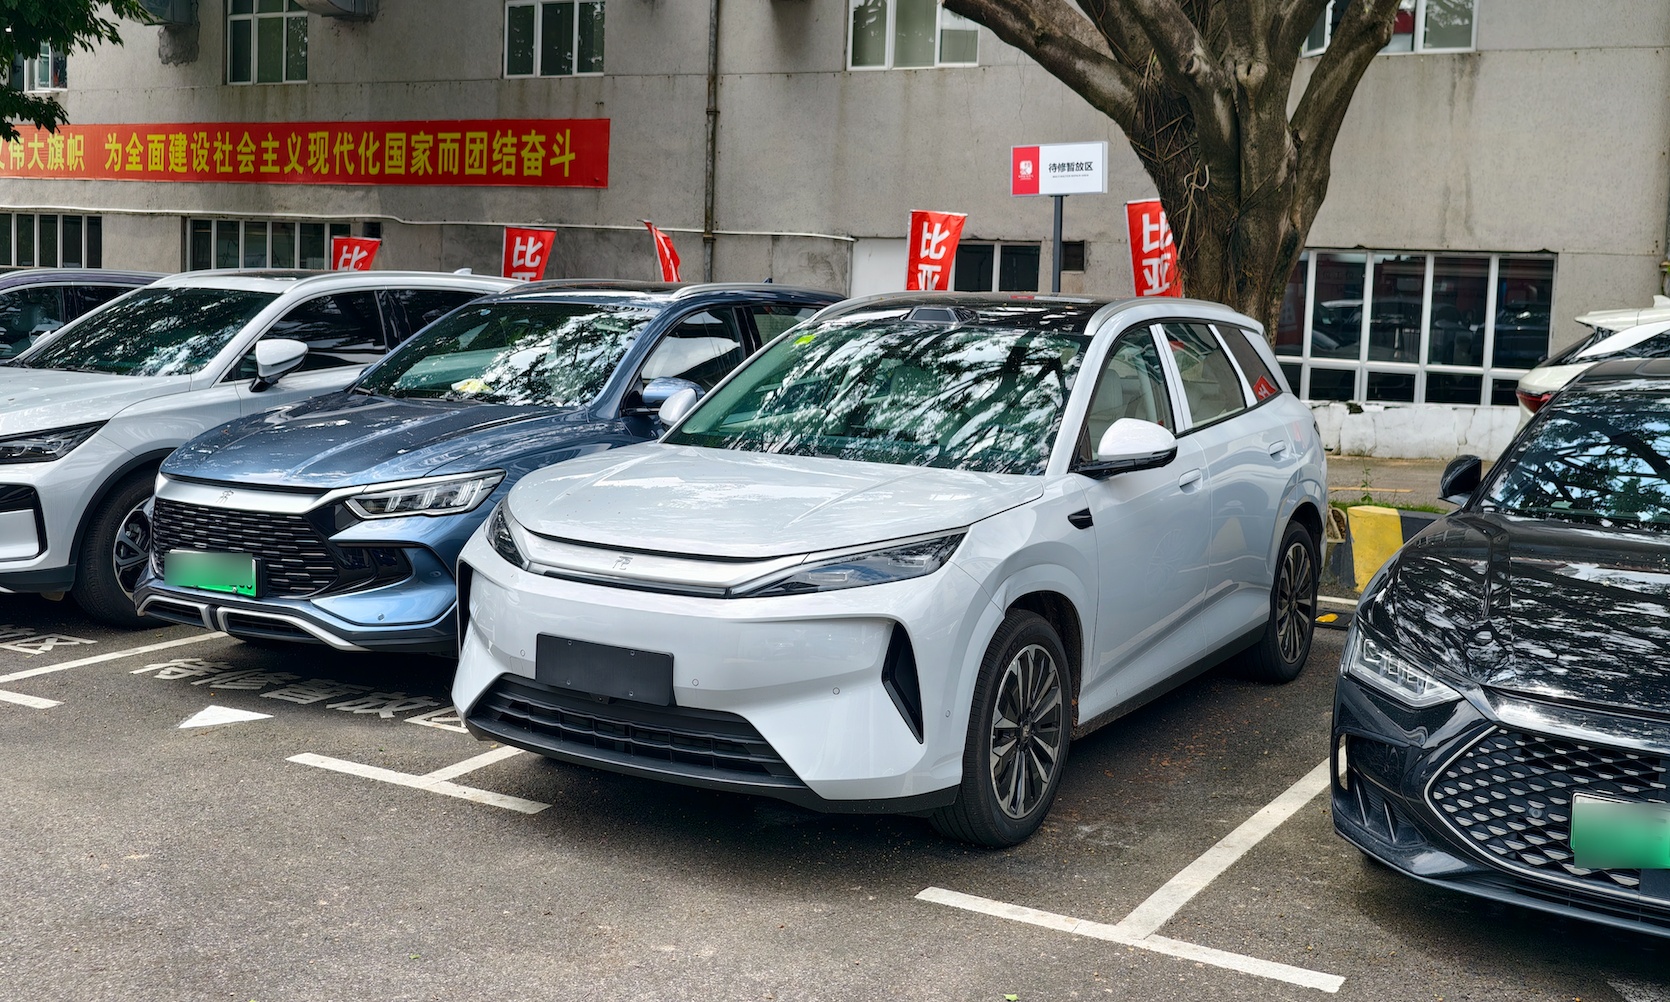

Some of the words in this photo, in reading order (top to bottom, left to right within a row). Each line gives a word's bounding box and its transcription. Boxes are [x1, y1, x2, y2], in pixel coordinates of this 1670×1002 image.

[104, 129, 575, 176] 为全面建设社会主义现代化国家而团结奋斗
[1048, 161, 1093, 173] 待修暂放区
[338, 246, 368, 271] 比
